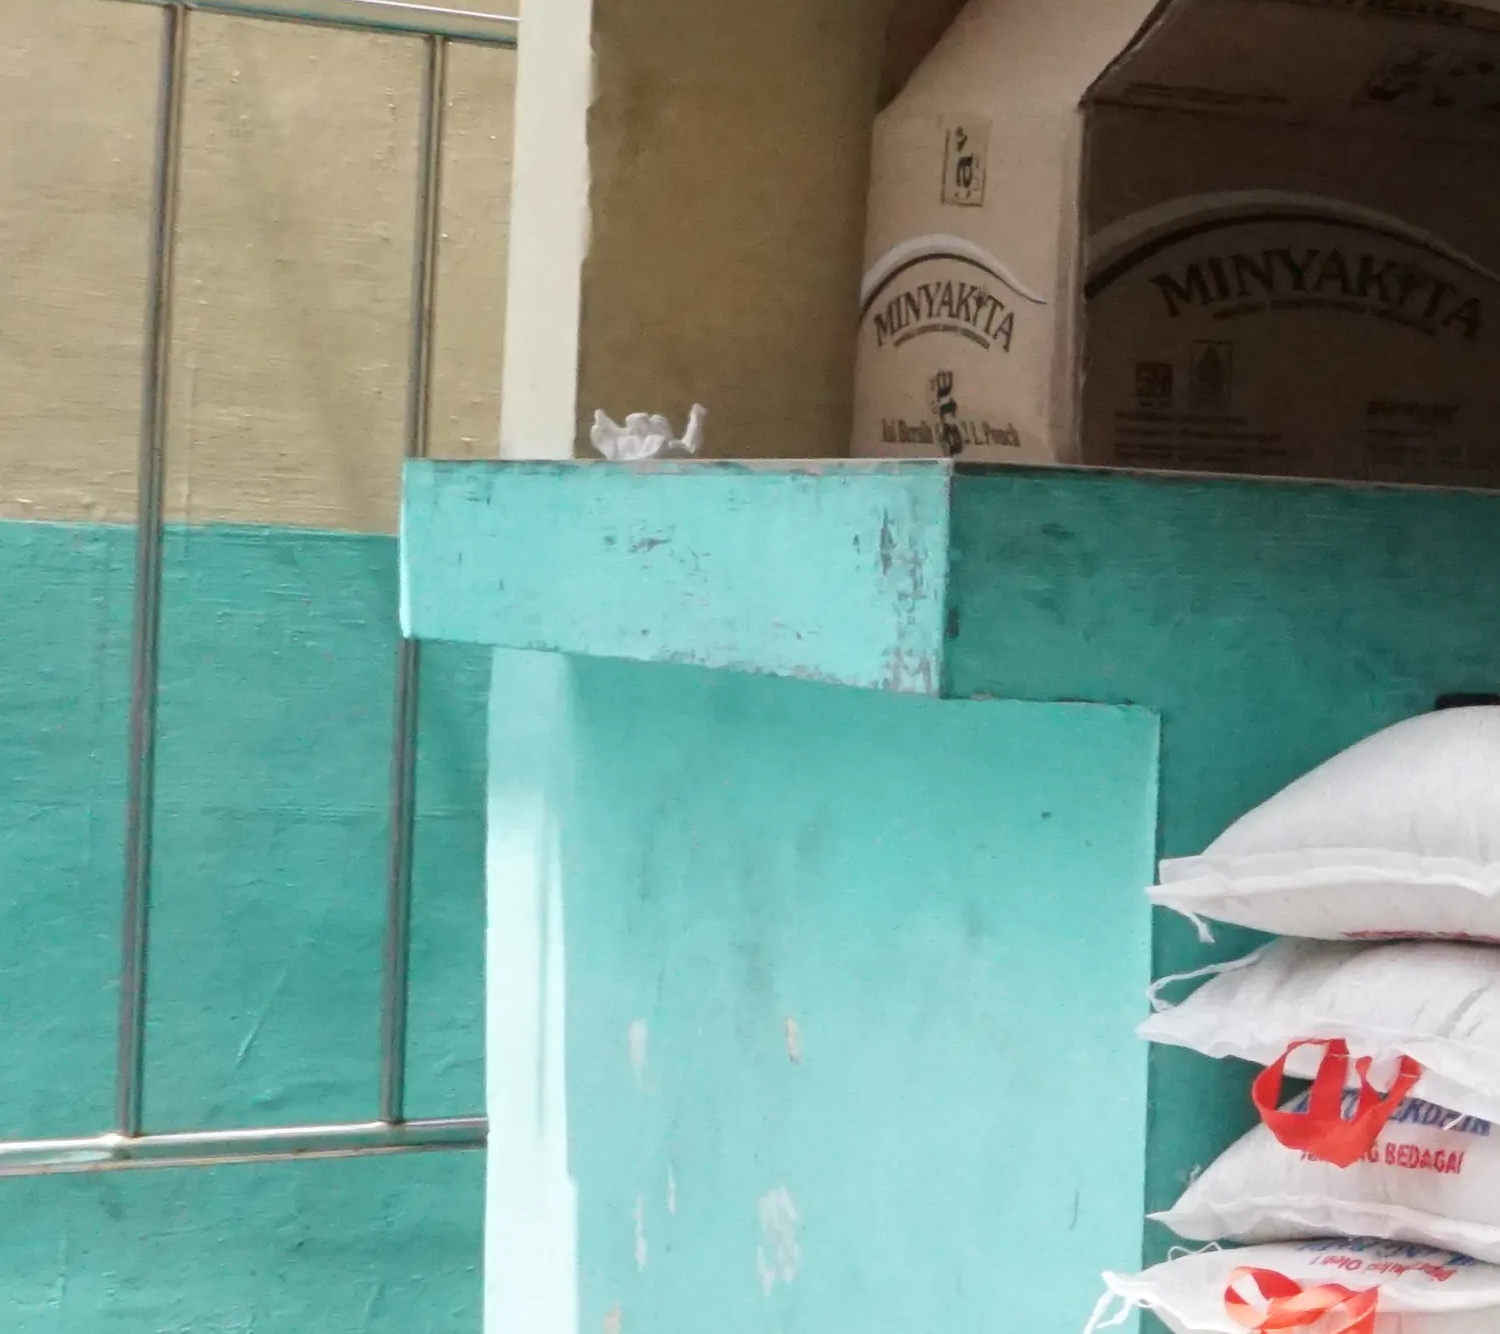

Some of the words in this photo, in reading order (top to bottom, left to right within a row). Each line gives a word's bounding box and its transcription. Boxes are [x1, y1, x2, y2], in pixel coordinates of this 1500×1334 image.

[872, 280, 1016, 353] MINYAKITA
[1150, 245, 1483, 343] MINYAKITA
[1384, 1141, 1465, 1175] BEDAGAI
